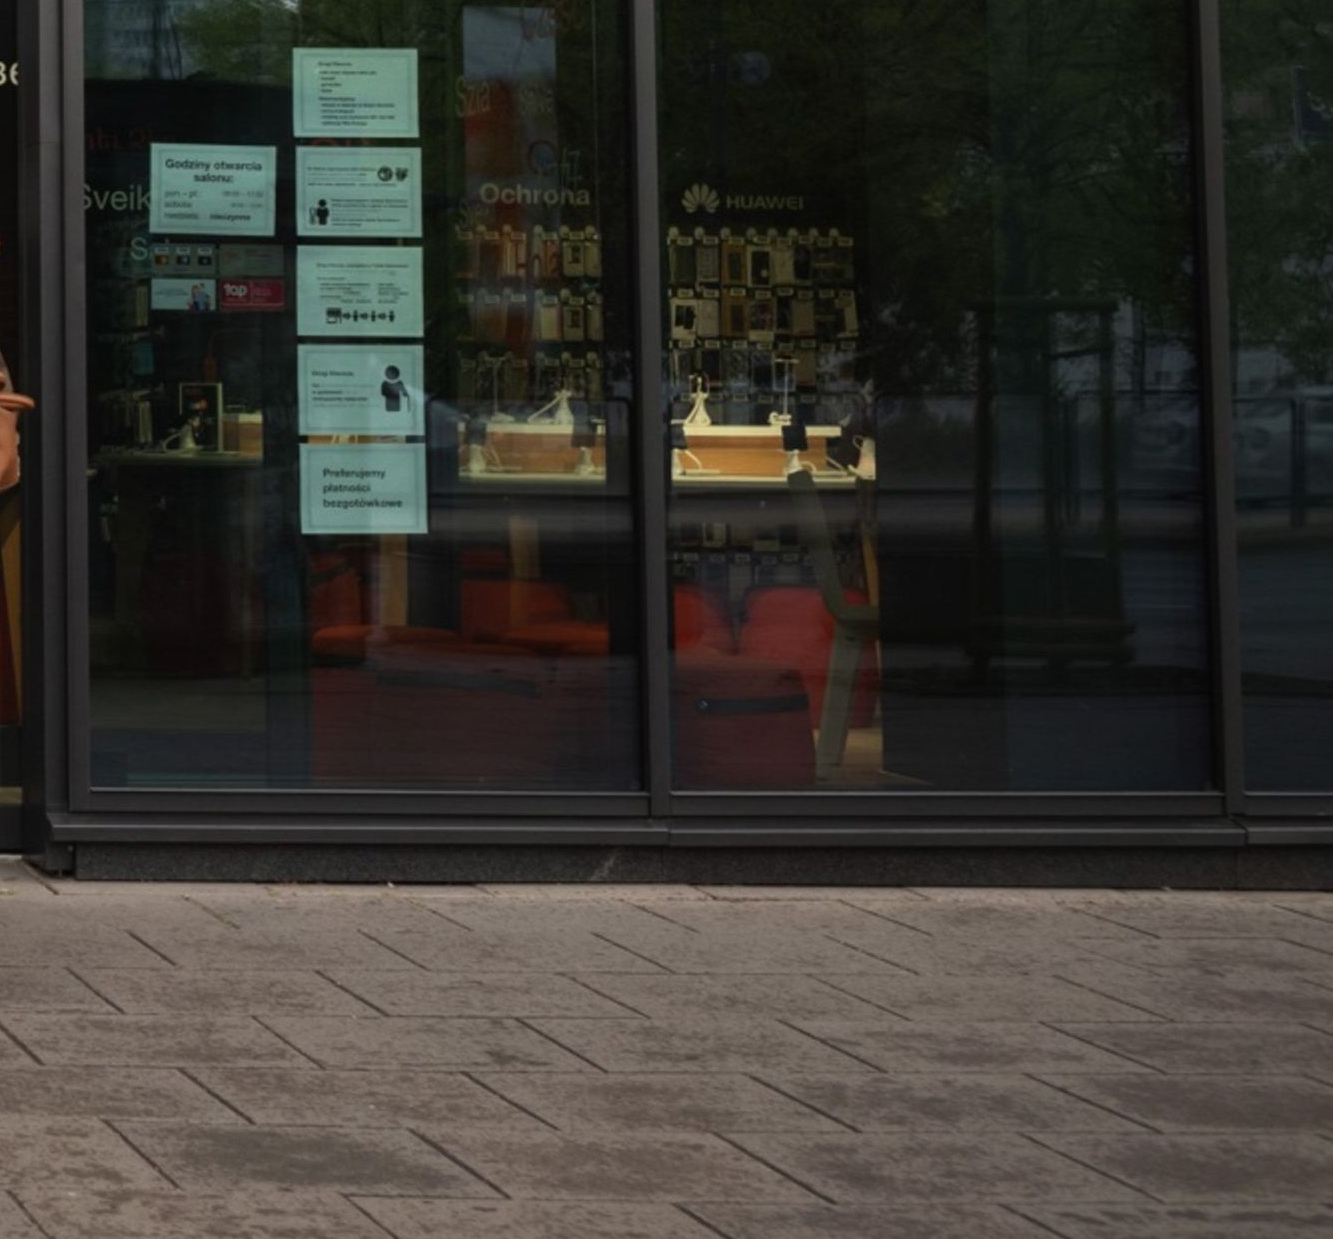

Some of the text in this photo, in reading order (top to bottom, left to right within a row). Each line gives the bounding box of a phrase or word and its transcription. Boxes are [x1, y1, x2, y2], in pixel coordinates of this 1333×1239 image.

[165, 158, 263, 172] Godziny otwarcia
[479, 183, 591, 206] Ochrona
[725, 194, 805, 210] HUAWEI
[322, 468, 387, 481] Preferujemy
[322, 483, 372, 495] płatności
[322, 497, 404, 511] bezgotówkowe
